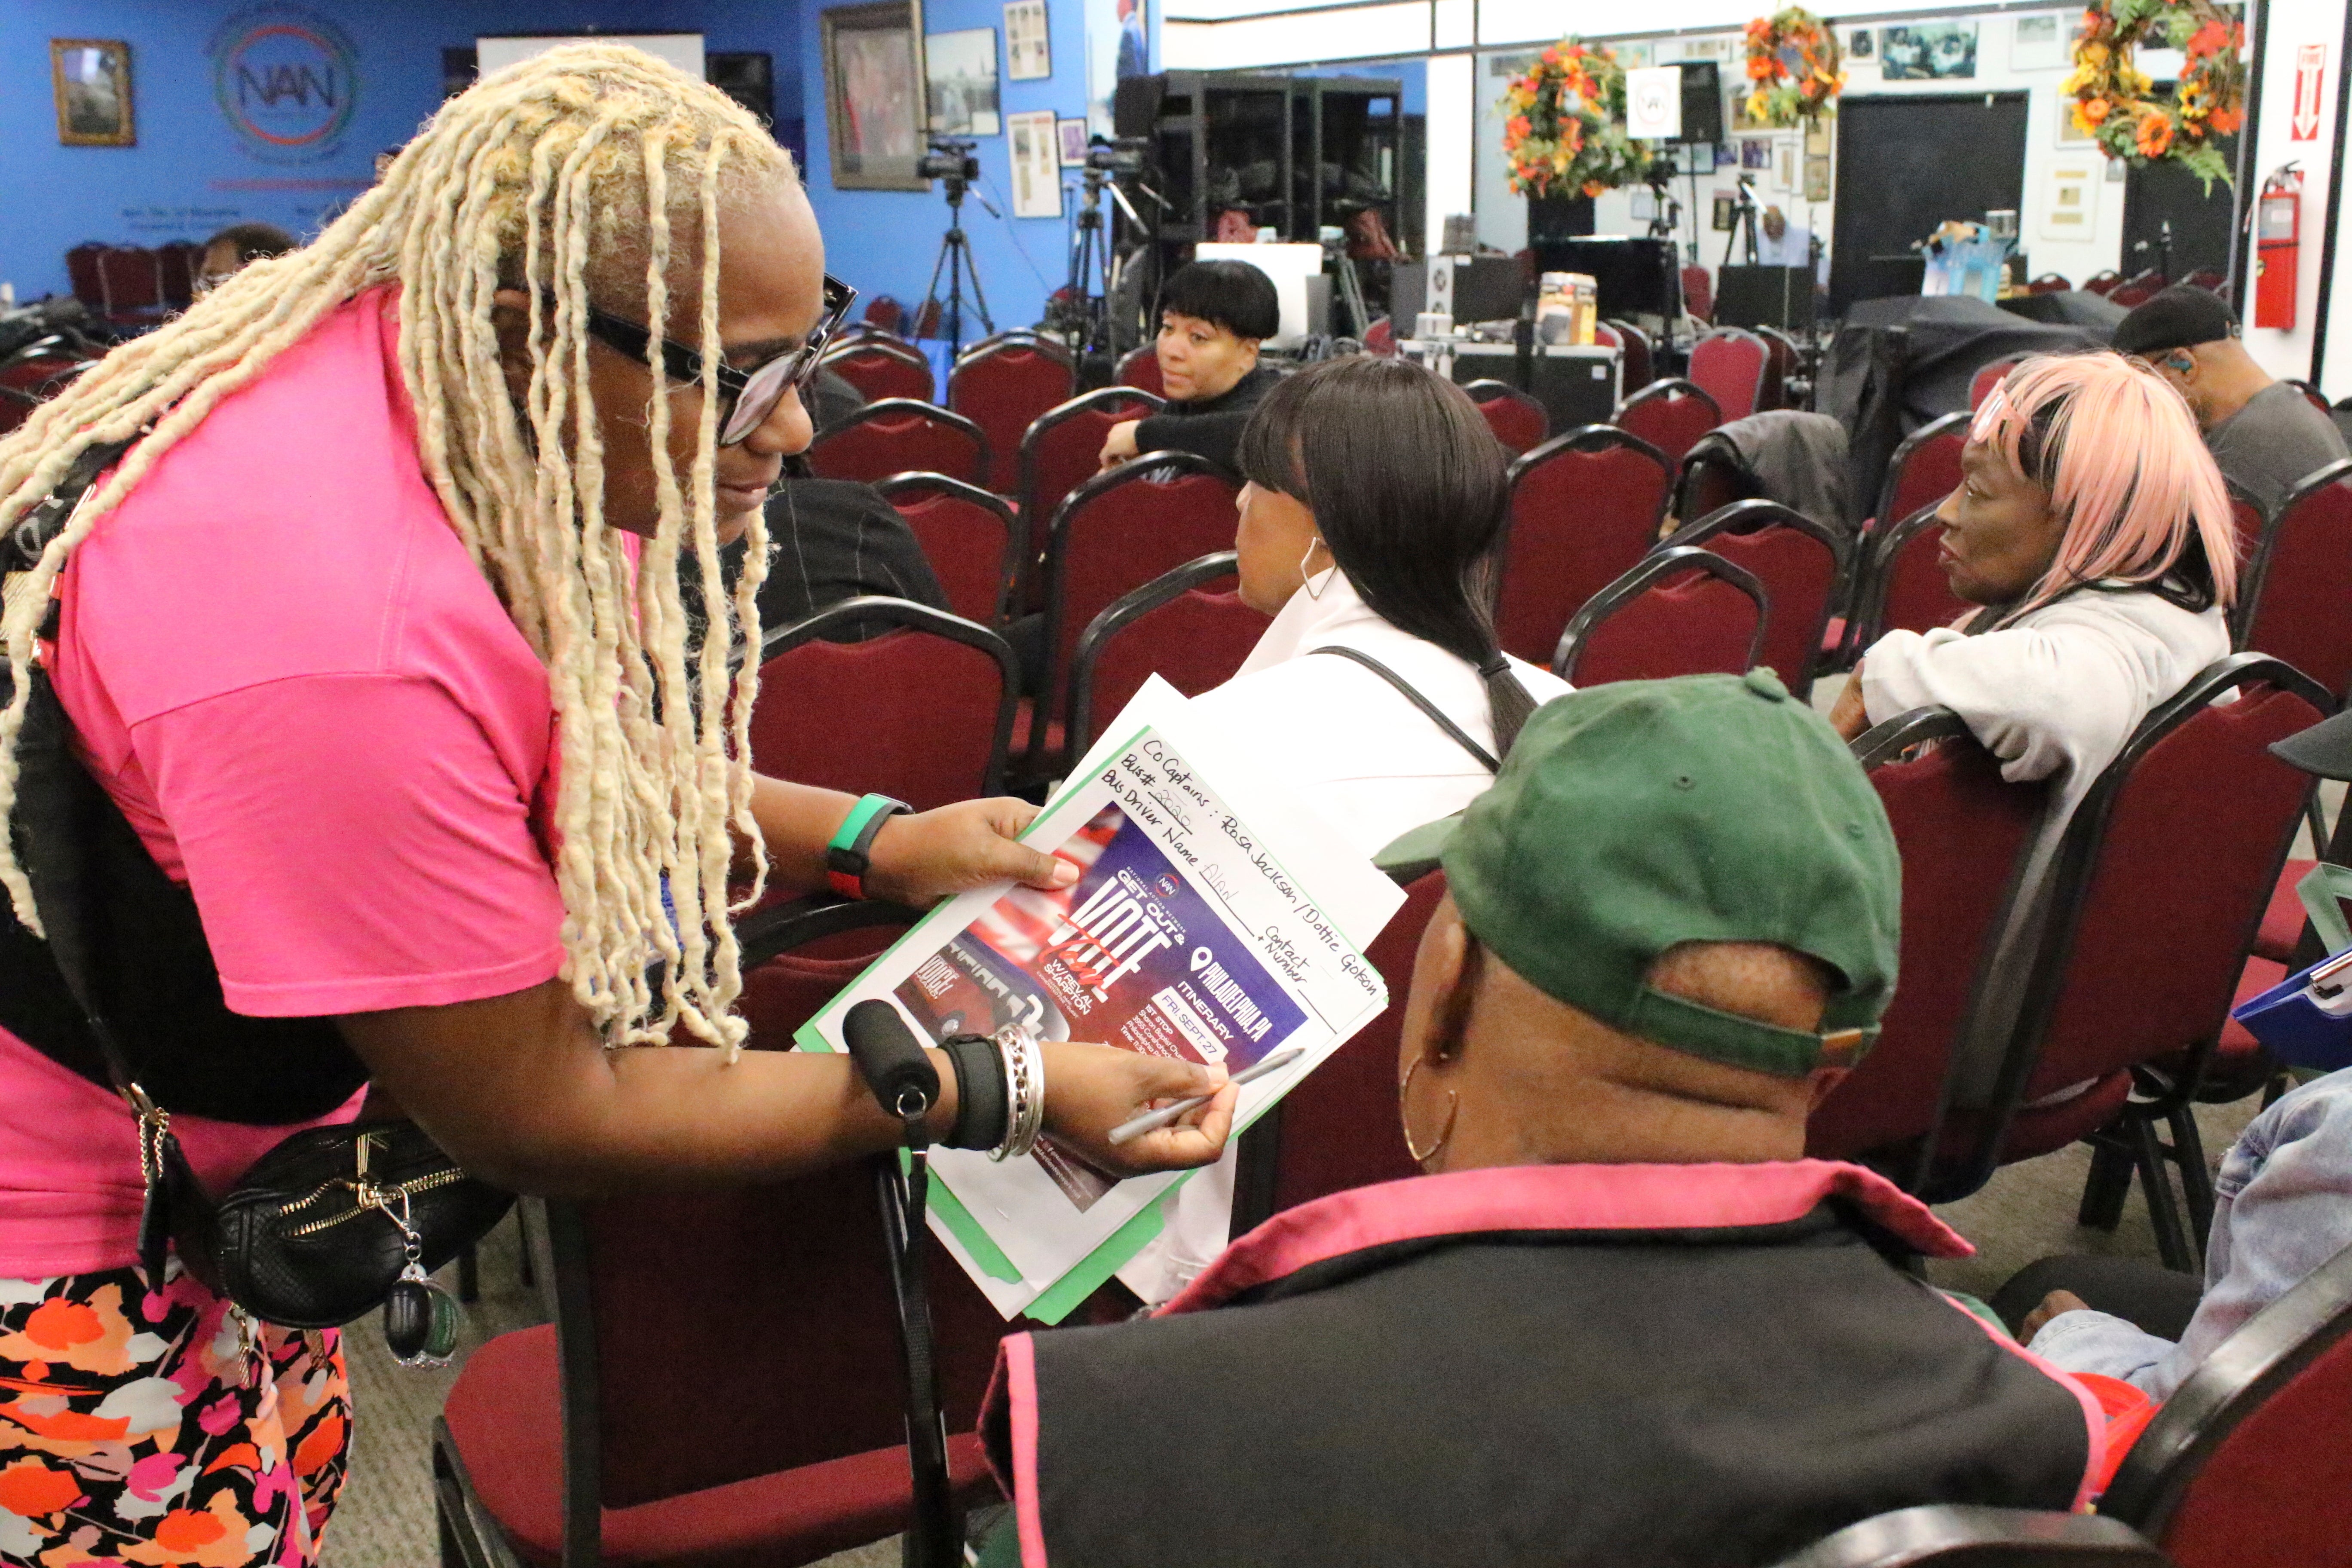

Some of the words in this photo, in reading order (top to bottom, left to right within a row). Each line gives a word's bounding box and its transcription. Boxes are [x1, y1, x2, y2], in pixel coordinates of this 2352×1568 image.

[238, 64, 334, 107] NAN
[1121, 753, 1155, 793] Bus#
[1101, 769, 1124, 793] Bus
[1124, 789, 1162, 825] Driver
[1162, 827, 1198, 866] Name
[1143, 740, 1163, 762] Co
[1162, 758, 1210, 807] Captains
[1221, 815, 1252, 854] Rosa
[1250, 852, 1296, 903] Jackson
[1118, 870, 1148, 899] GET
[1125, 865, 1149, 891] NATIONAL
[1147, 890, 1166, 910] ACTION
[1164, 910, 1187, 934] NETWORK
[1158, 877, 1176, 895] NAN
[1047, 876, 1172, 1003] VOTE
[1265, 925, 1310, 968] Contact
[1264, 942, 1307, 982] Number
[1041, 962, 1091, 1017] SHARPTON
[1177, 980, 1234, 1040] ITINERARY
[1118, 1024, 1136, 1043] Time:
[1124, 1019, 1156, 1054] Philadelphia
[1131, 1014, 1147, 1031] 3955
[1137, 1008, 1158, 1031] Sharon
[1152, 1026, 1173, 1048] Baptist
[1143, 1003, 1158, 1018] 1ST
[1154, 1014, 1174, 1036] STOP
[1161, 995, 1180, 1014] FRI.
[1179, 1014, 1206, 1040] SEPT.
[1202, 1041, 1217, 1053] 27
